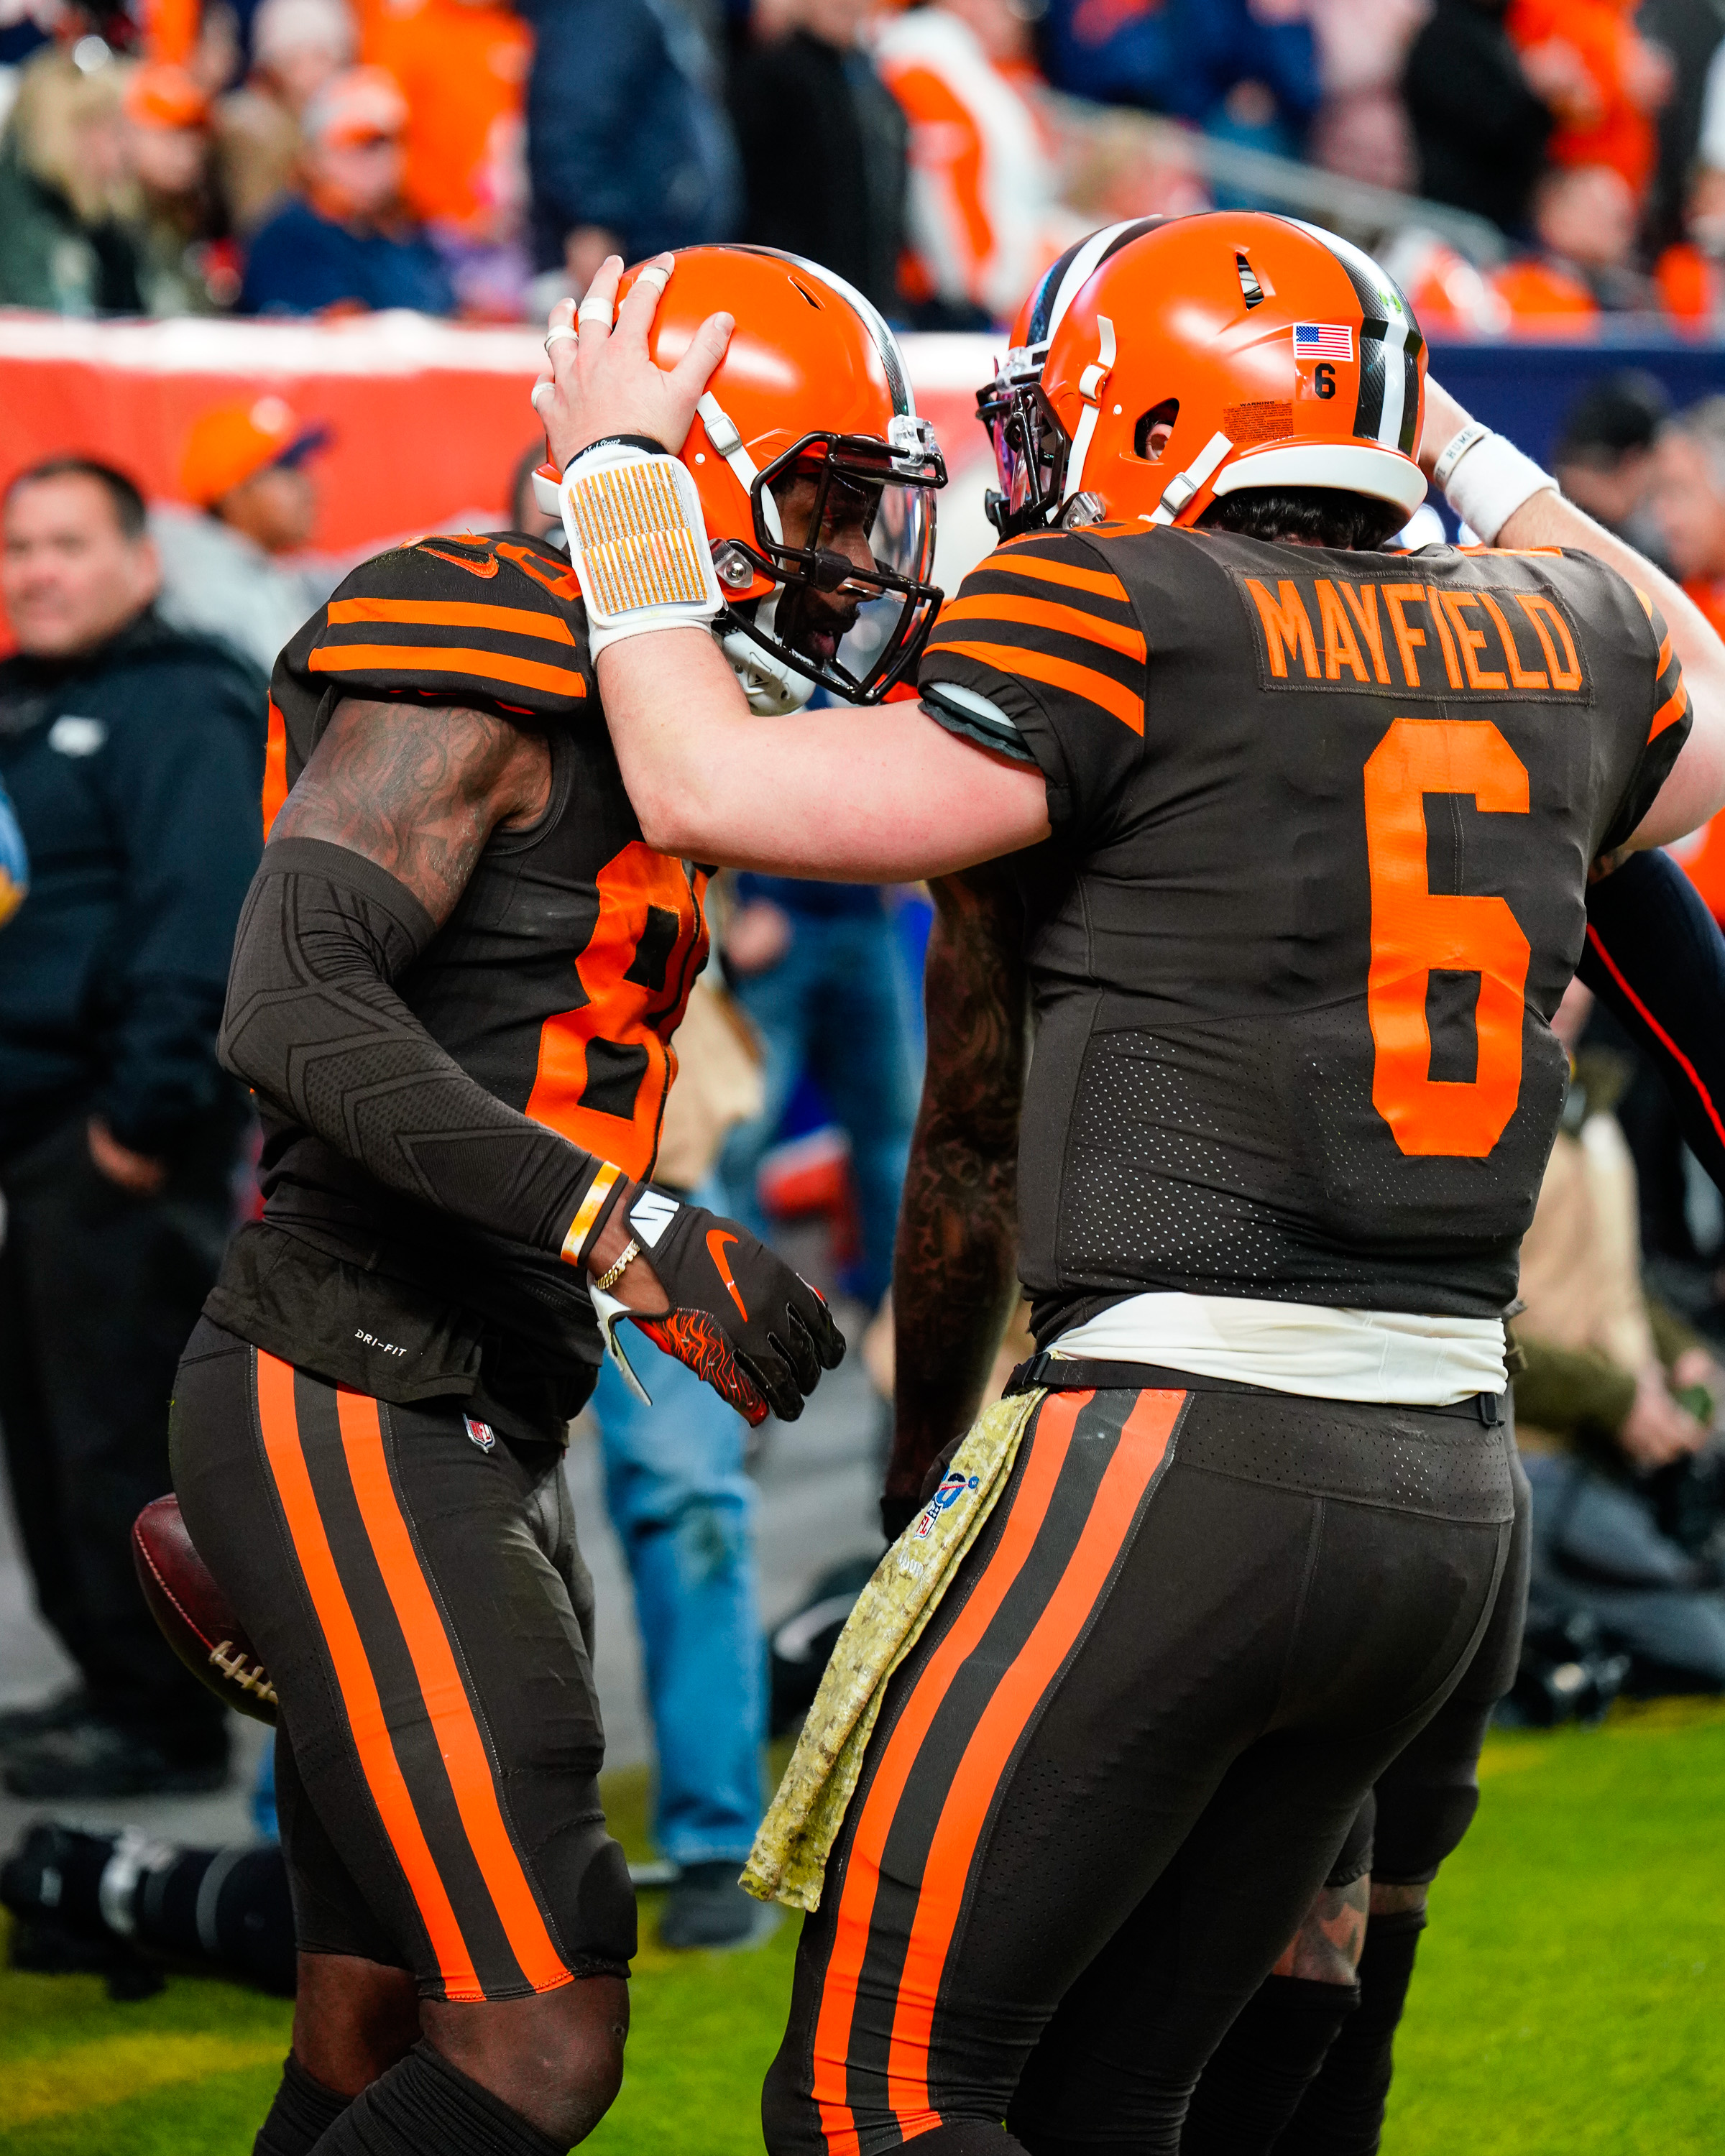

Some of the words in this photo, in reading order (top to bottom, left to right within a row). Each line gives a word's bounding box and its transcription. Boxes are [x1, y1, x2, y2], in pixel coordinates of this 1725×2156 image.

[1315, 362, 1336, 400] 6
[1244, 579, 1583, 691] MAYFIELD
[1363, 717, 1531, 1157] 6
[354, 1328, 408, 1357] DRI-FIT
